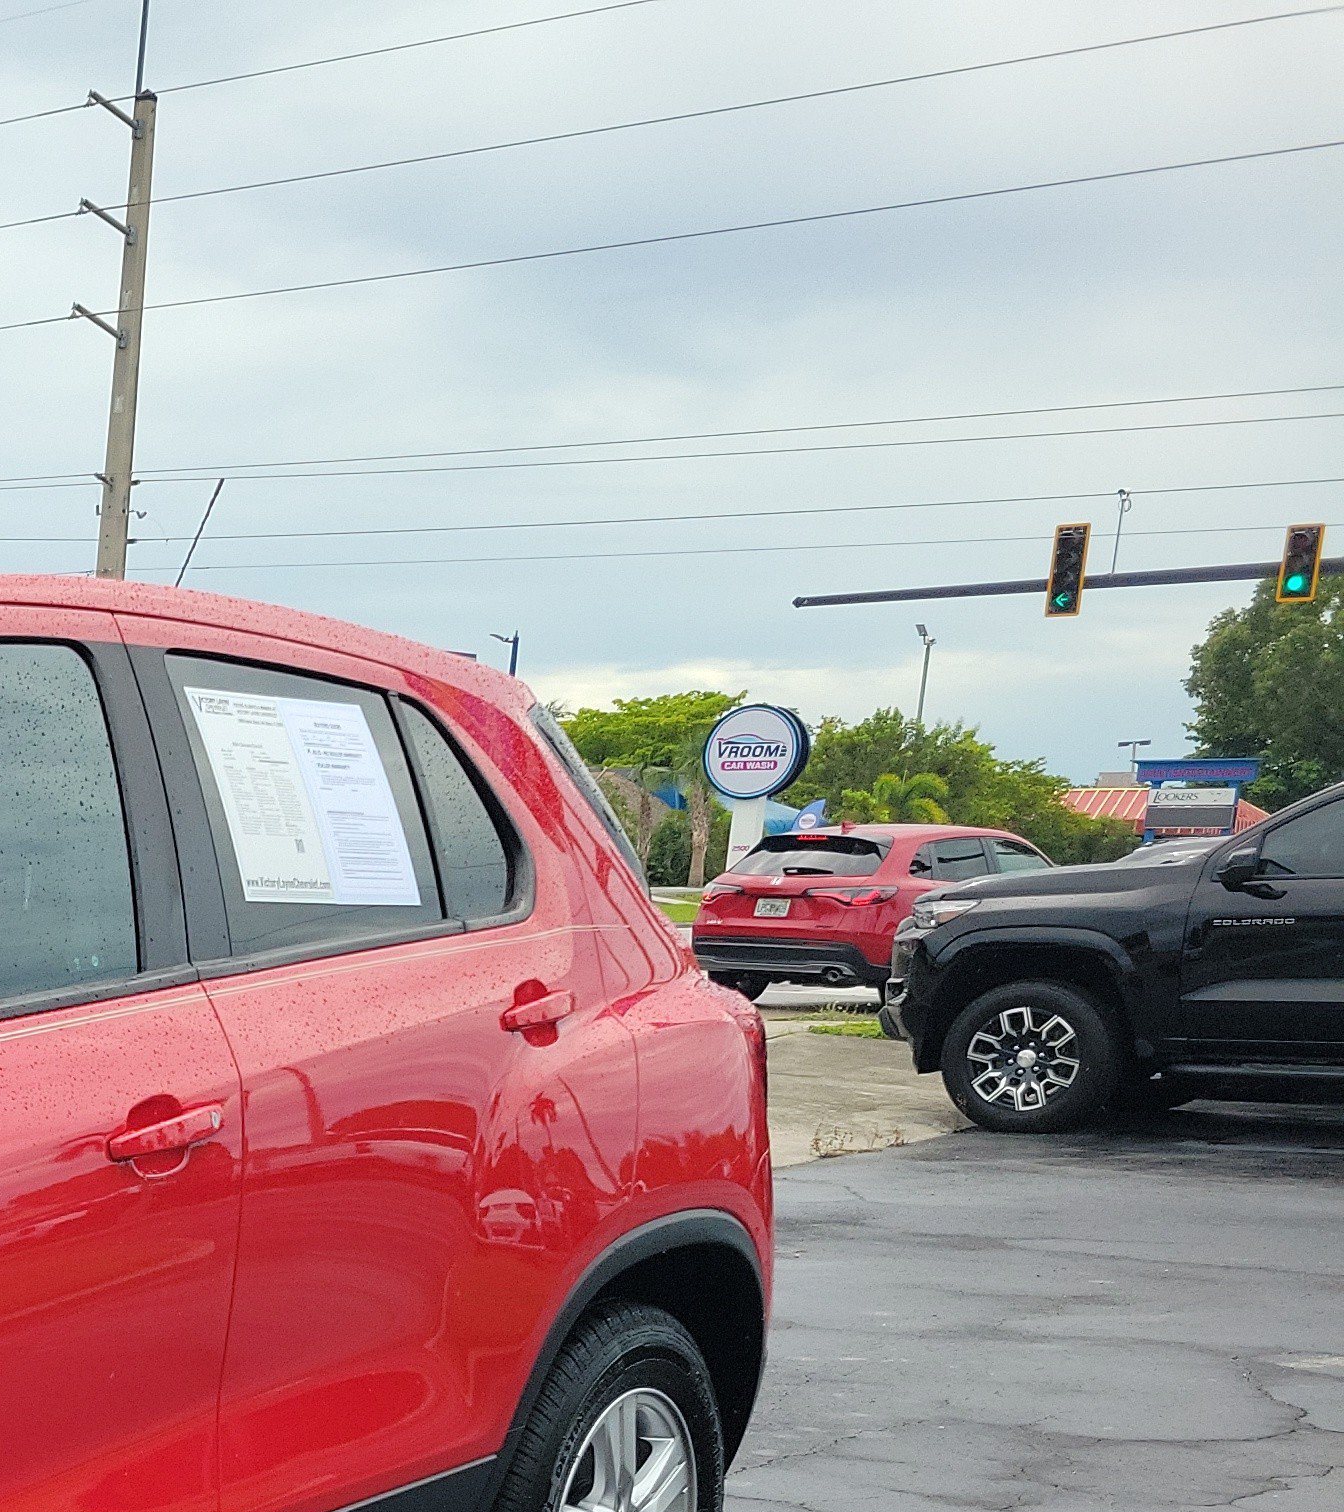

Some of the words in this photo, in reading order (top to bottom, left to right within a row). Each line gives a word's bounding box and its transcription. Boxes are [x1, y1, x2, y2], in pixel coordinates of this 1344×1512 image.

[718, 742, 779, 758] VROOM
[724, 762, 744, 770] CAR
[746, 761, 774, 770] WASH
[1153, 790, 1198, 803] LOOKERS
[1212, 918, 1295, 926] COLORADO
